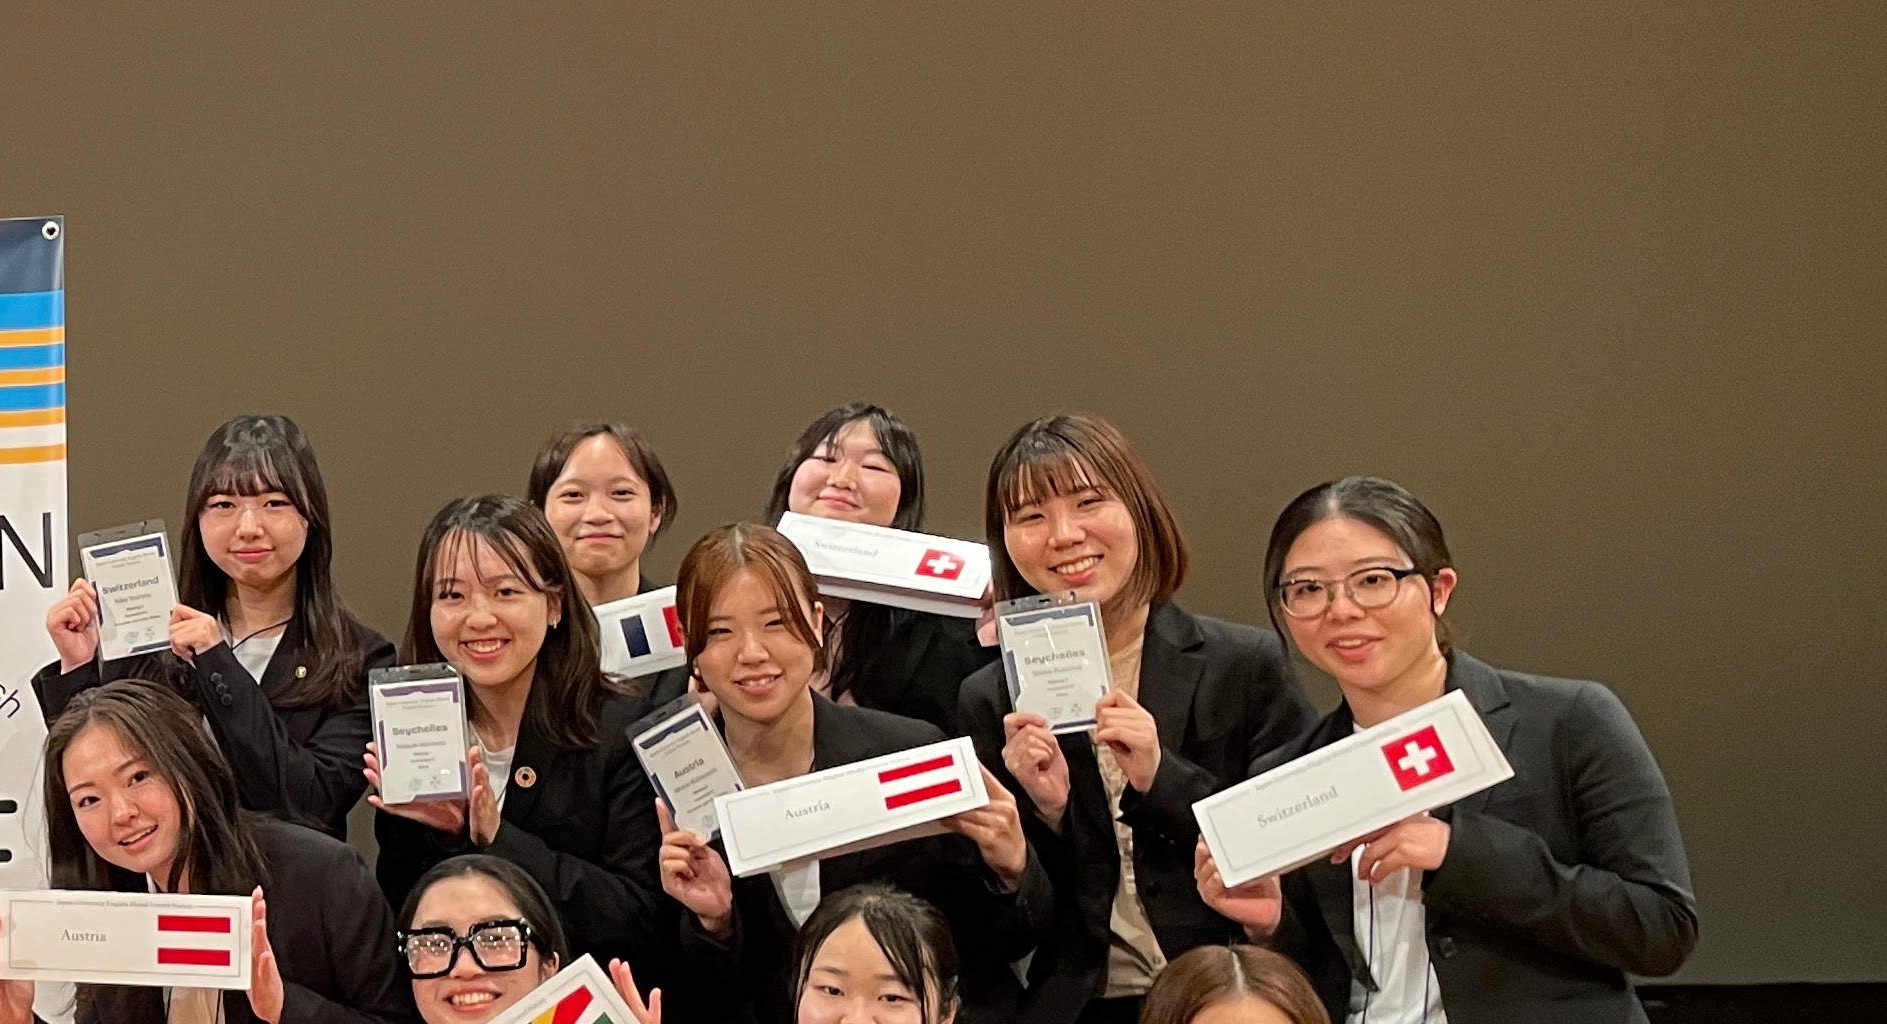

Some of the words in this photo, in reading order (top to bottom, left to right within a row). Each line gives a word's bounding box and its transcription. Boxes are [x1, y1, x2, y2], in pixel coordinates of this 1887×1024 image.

[102, 576, 160, 594] Switzerland
[674, 758, 705, 779] Austria
[784, 799, 831, 822] Austria
[1257, 784, 1339, 829] Switzerland
[61, 928, 107, 943] Austria
